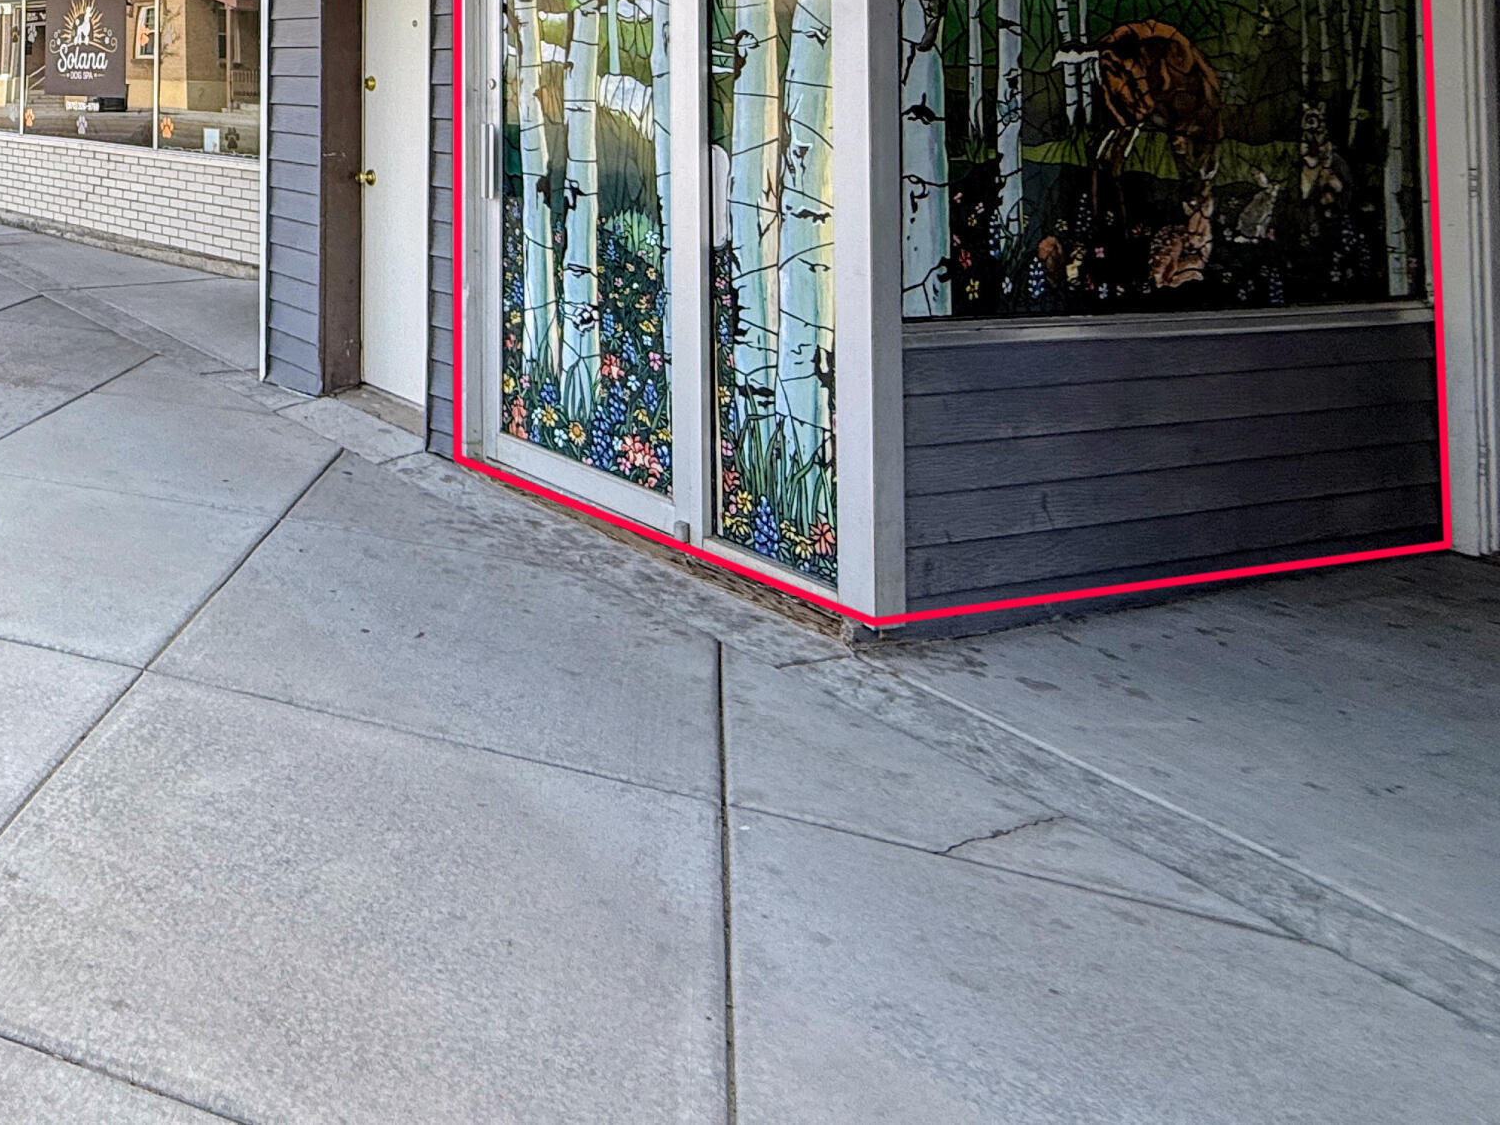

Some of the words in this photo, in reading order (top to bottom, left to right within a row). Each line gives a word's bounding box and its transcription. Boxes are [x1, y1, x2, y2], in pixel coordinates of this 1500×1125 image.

[57, 43, 108, 72] Solana
[70, 71, 82, 80] DOG
[83, 71, 94, 80] SPA
